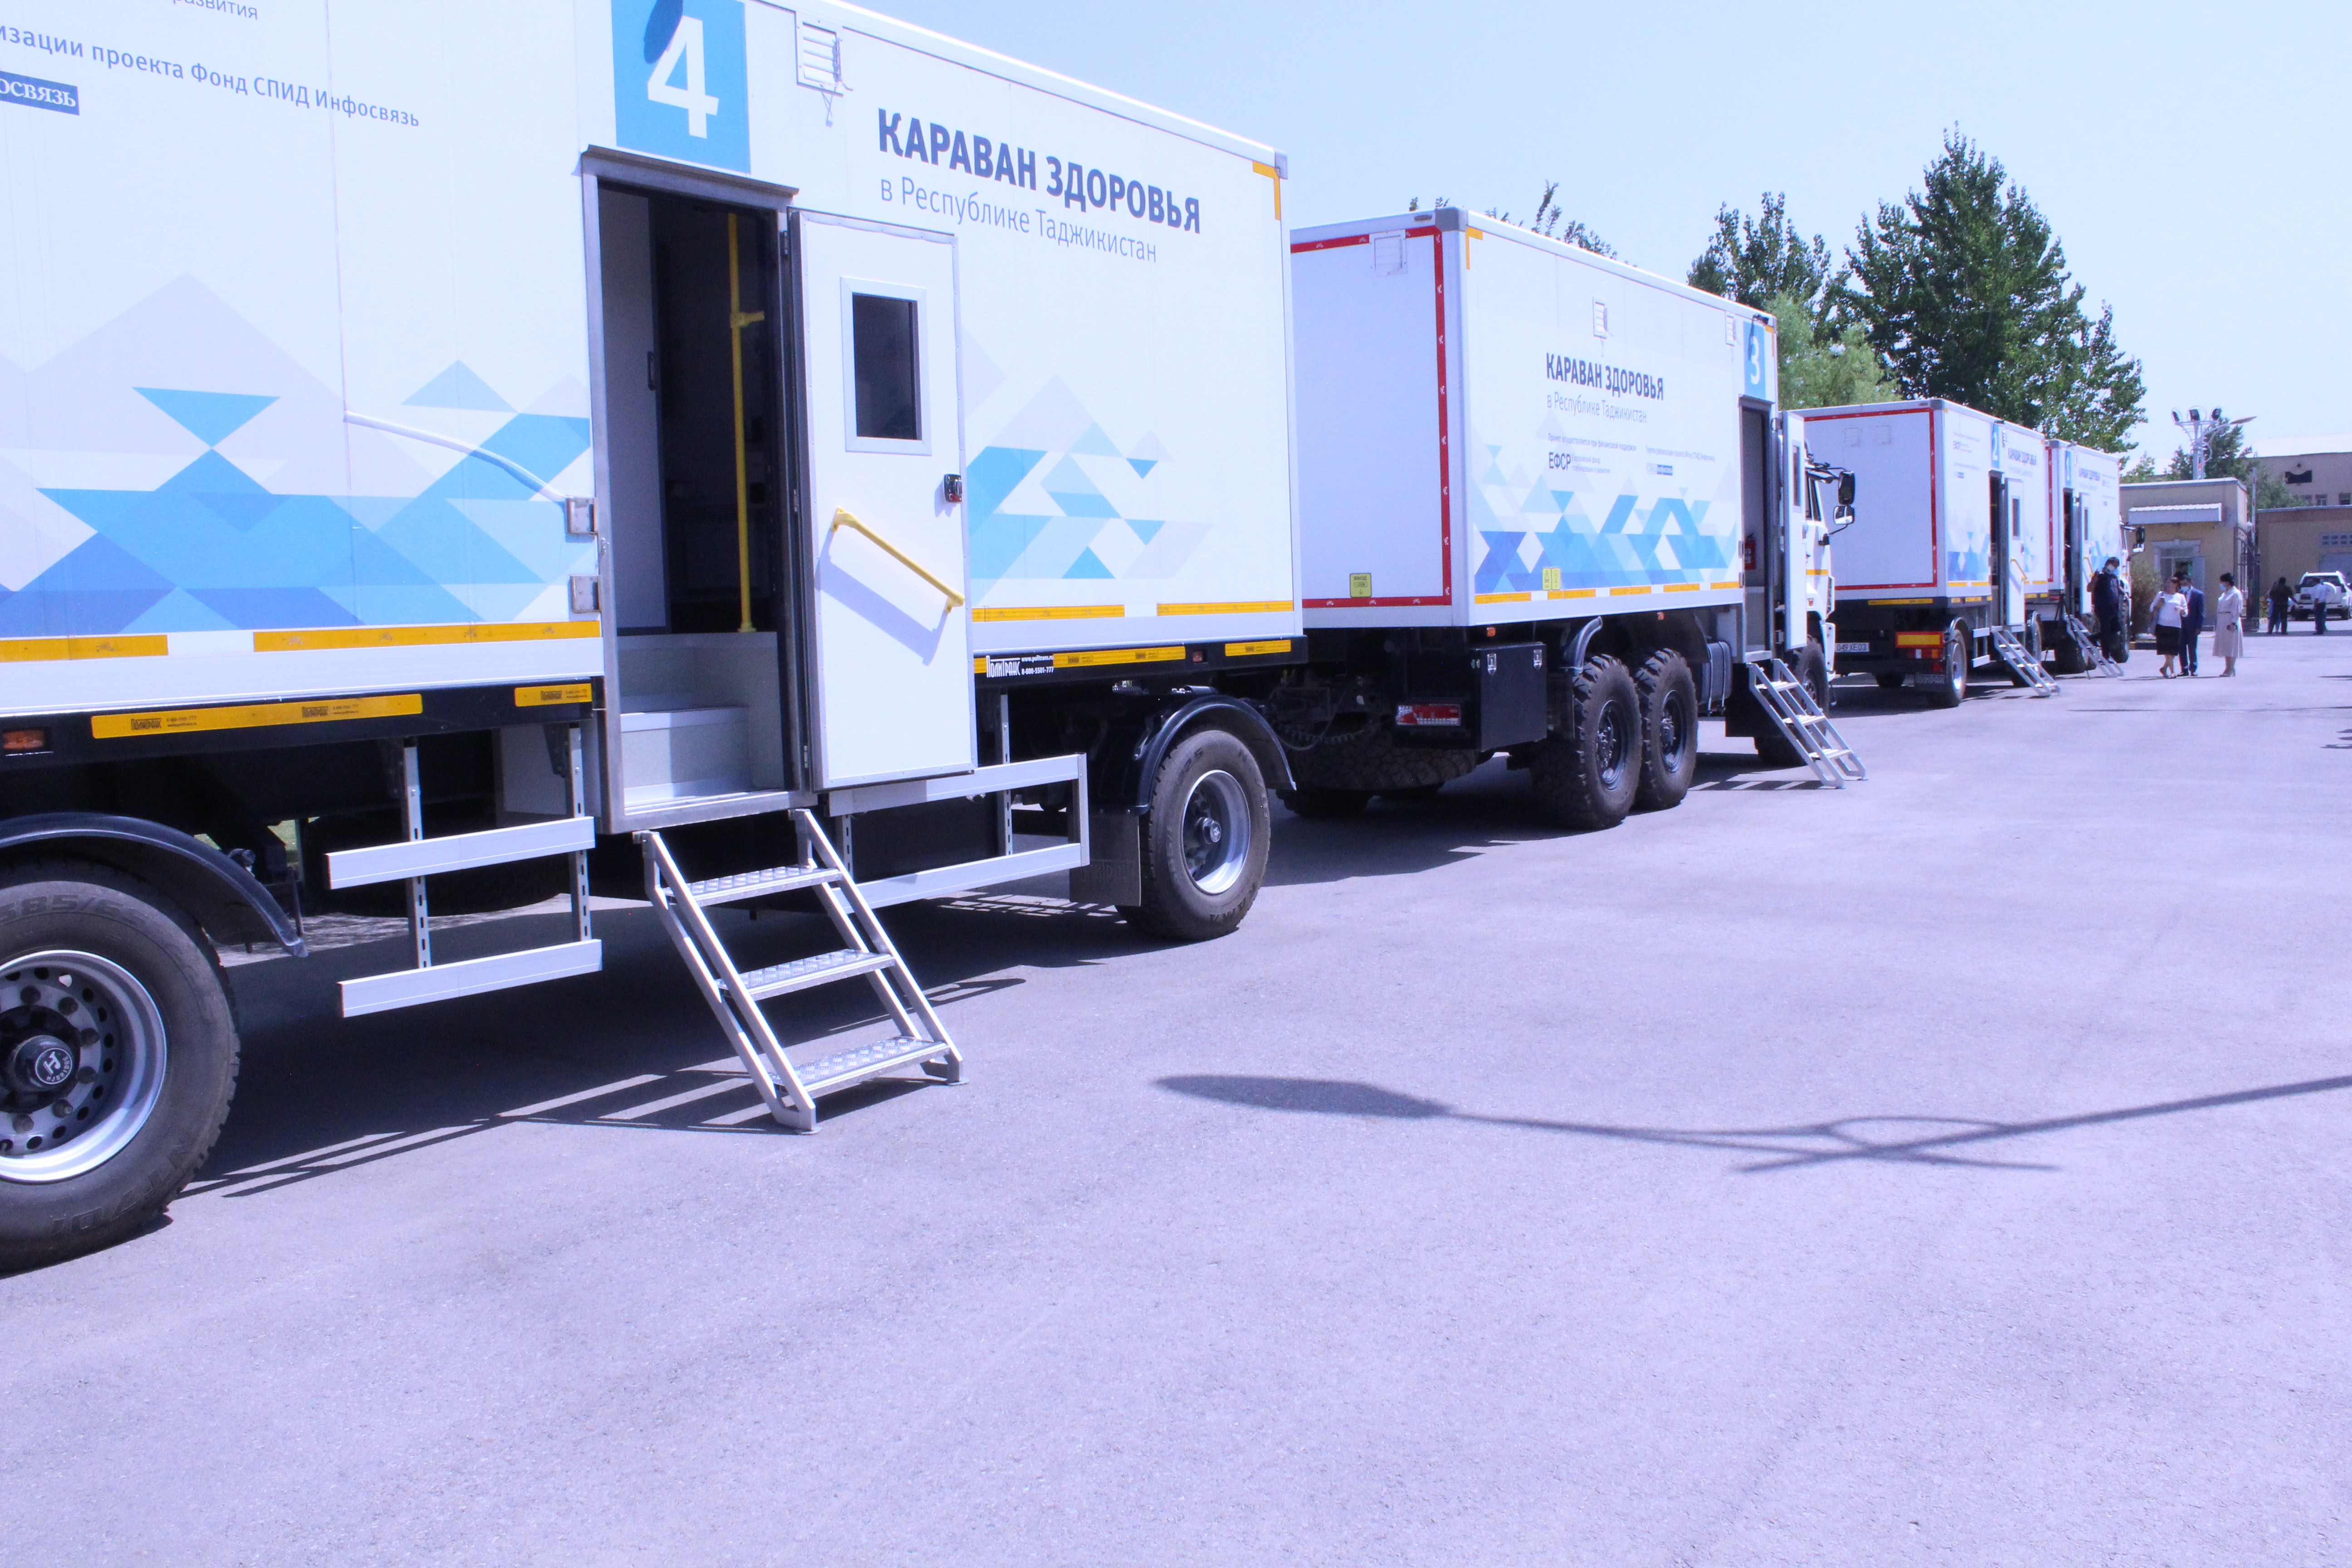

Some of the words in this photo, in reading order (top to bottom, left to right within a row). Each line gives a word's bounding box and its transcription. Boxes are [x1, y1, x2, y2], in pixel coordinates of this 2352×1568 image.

[173, 0, 258, 20] звития
[92, 46, 184, 79] проекта
[191, 63, 248, 95] Фонд
[254, 77, 310, 109] СПИД
[316, 89, 419, 127] Инфосвязь
[647, 15, 719, 139] 4
[878, 108, 1037, 191] КАРАВАН
[1046, 156, 1200, 235] ЗДОРОВЬЯ
[881, 179, 893, 202] в
[902, 176, 1030, 233] Республике
[1035, 209, 1156, 263] Таджикистан
[1546, 353, 1602, 389] КАРАВАН
[1605, 365, 1663, 401] ЗДОРОВЬЯ
[1750, 336, 1760, 385] 3
[1547, 394, 1552, 408] в
[1554, 391, 1600, 416] Республике
[1602, 399, 1647, 424] Таджикистан
[1548, 452, 1571, 470] ЕФСР
[1021, 655, 1054, 663] www.politrans.ru
[1021, 666, 1054, 675] 8-800-5501-777
